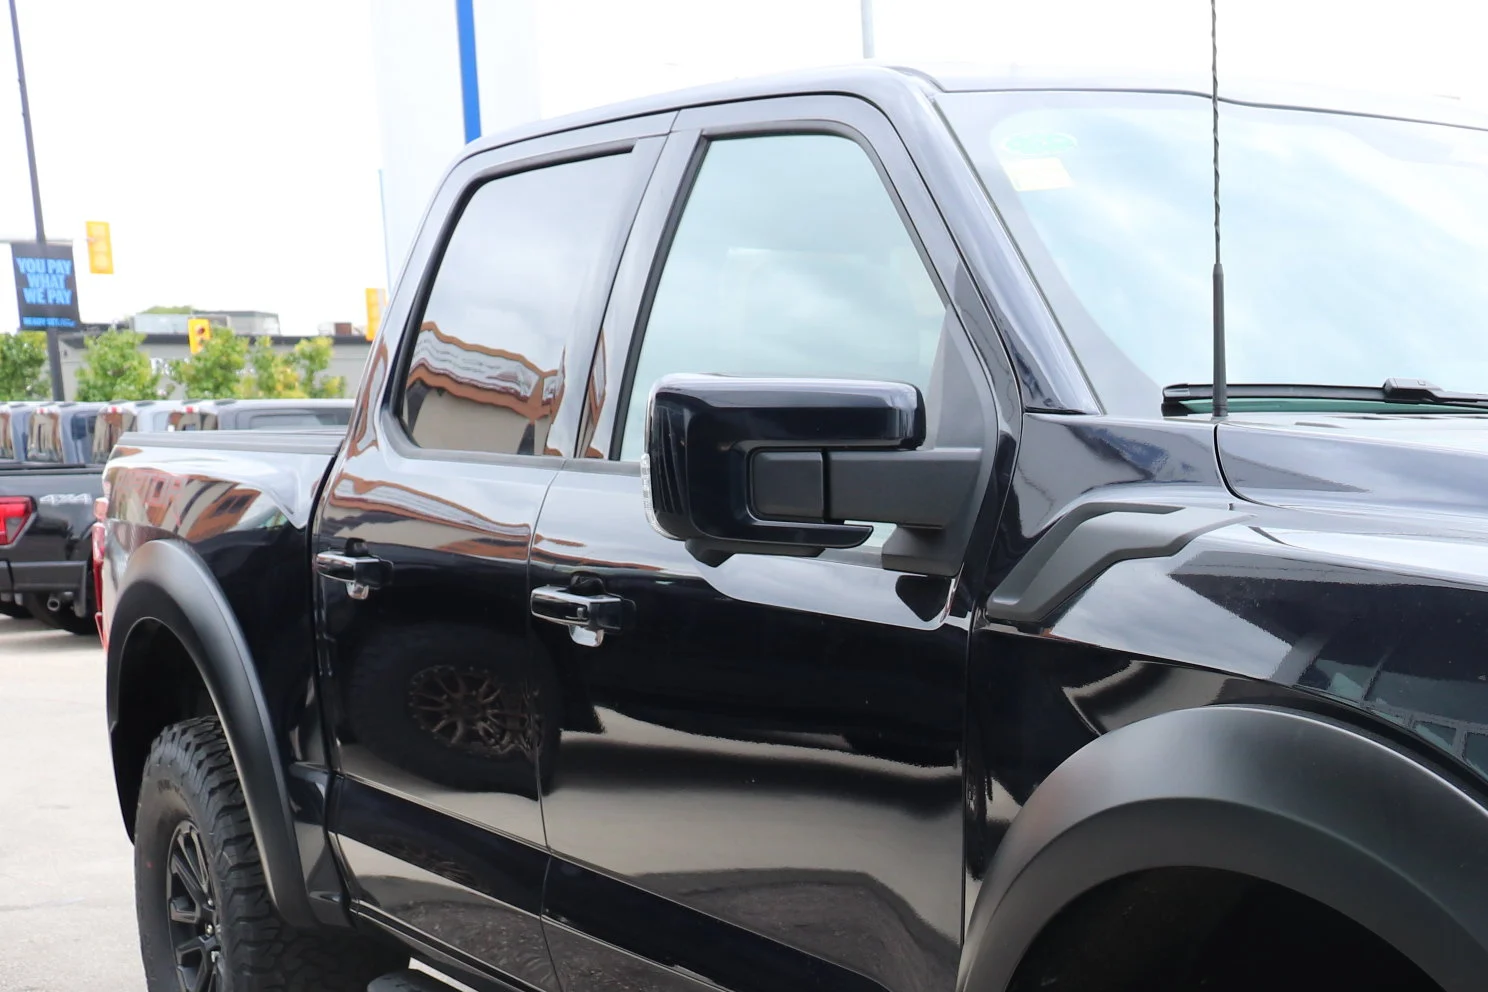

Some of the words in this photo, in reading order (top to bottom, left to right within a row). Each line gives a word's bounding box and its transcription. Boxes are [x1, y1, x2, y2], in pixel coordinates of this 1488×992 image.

[15, 257, 46, 274] YOU
[46, 258, 72, 275] PAY
[26, 273, 67, 289] WHAT
[22, 287, 46, 304] WE
[46, 288, 73, 305] PAY
